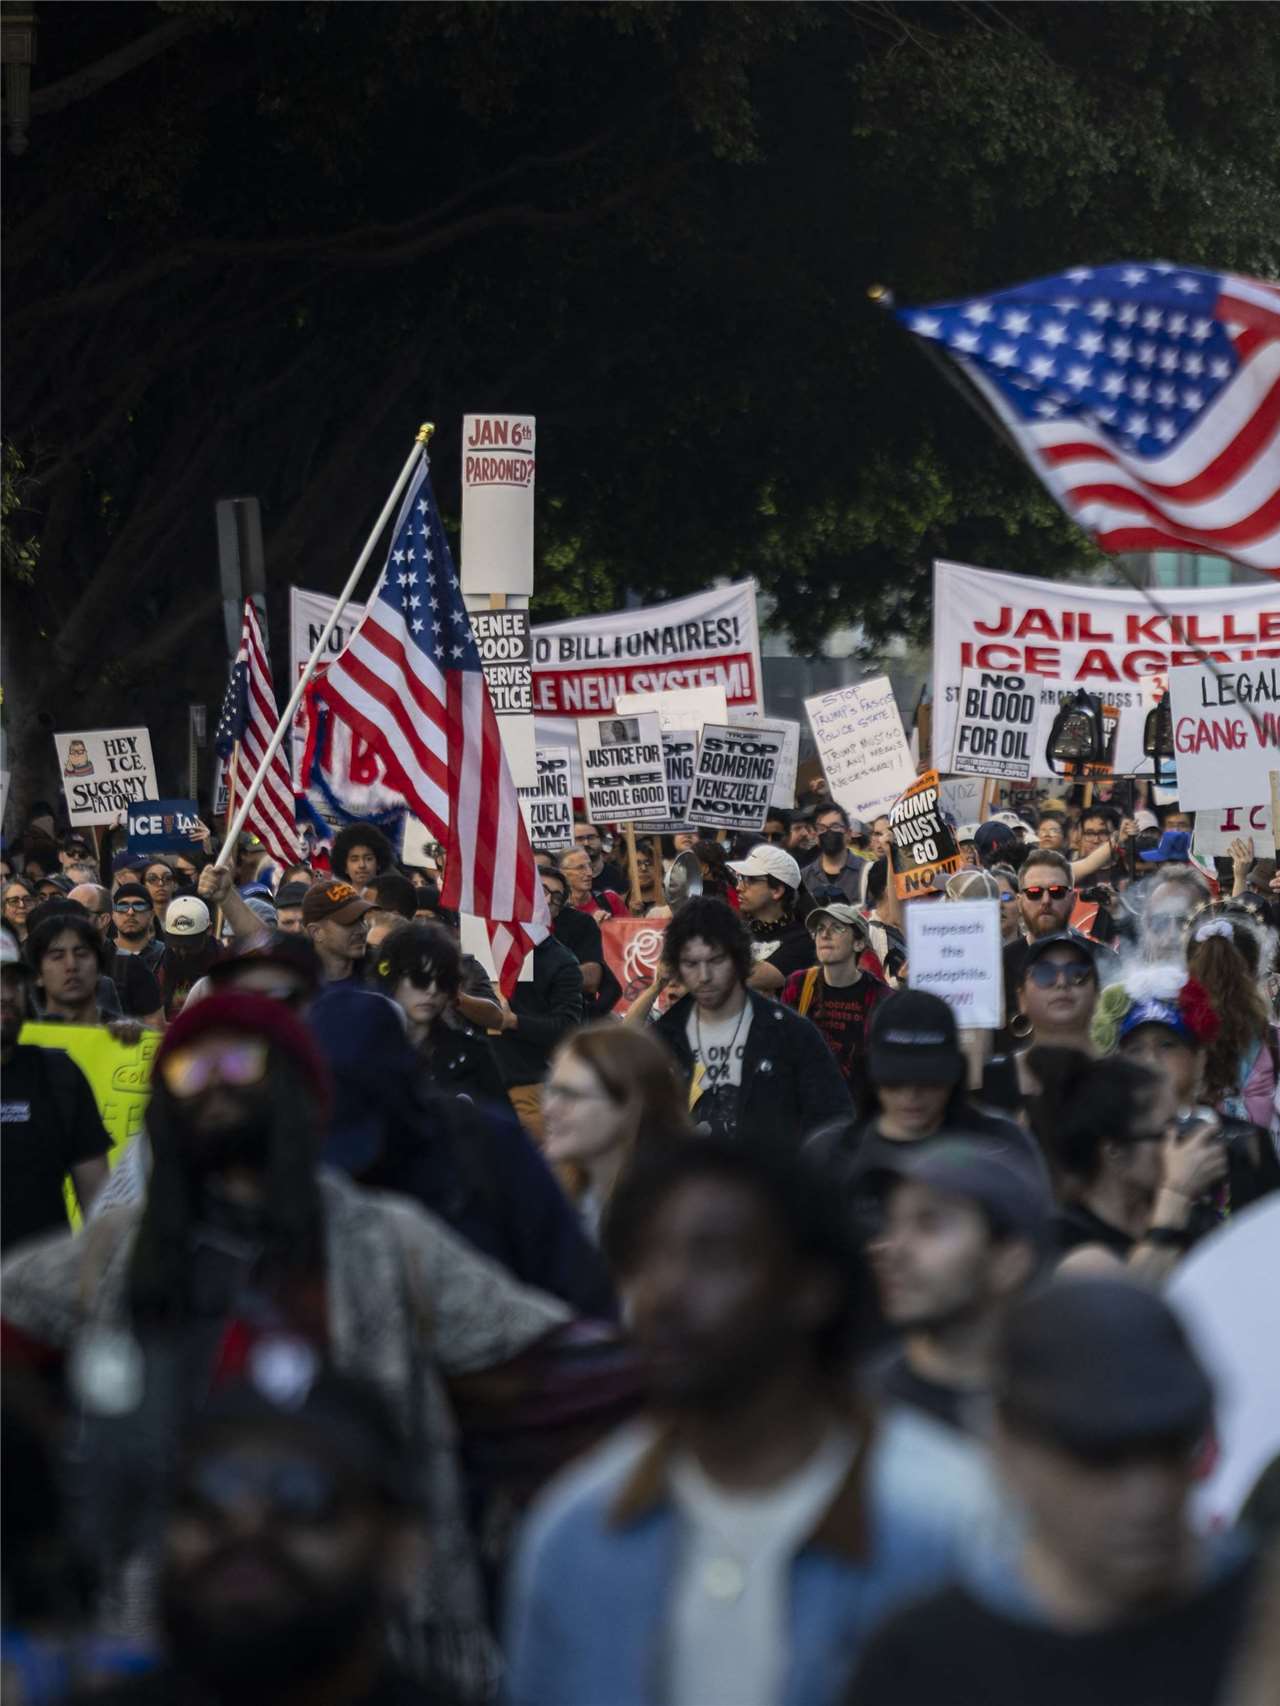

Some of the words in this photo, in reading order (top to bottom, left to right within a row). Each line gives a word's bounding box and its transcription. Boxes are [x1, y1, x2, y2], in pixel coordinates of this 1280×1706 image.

[468, 420, 509, 447] JAN
[511, 423, 532, 446] 6th
[466, 456, 535, 484] PARDONED?
[974, 607, 1113, 643] JAIL
[559, 616, 742, 663] BILLIONAIRES!
[960, 642, 1061, 680] ICE
[564, 671, 626, 711] NEW
[981, 673, 1026, 692] NO
[965, 688, 1035, 725] BLOOD
[103, 736, 138, 757] HEY
[704, 738, 780, 757] STOP
[958, 725, 999, 758] FOR
[1001, 730, 1031, 761] OIL
[1175, 715, 1248, 754] GANG
[586, 746, 635, 769] JUSTICE
[636, 744, 661, 764] FOR
[700, 752, 775, 780] BOMBING
[72, 779, 125, 808] SUCK
[124, 775, 148, 801] MY
[588, 771, 663, 788] RENEE
[697, 779, 768, 803] VENEZUELA
[589, 787, 631, 808] NICOLE
[632, 785, 665, 806] GOOD
[691, 798, 765, 817] NOW!
[129, 816, 163, 836] ICE
[892, 813, 941, 848] MUST
[912, 838, 938, 865] GO
[922, 922, 984, 937] Impeach
[941, 944, 964, 958] the
